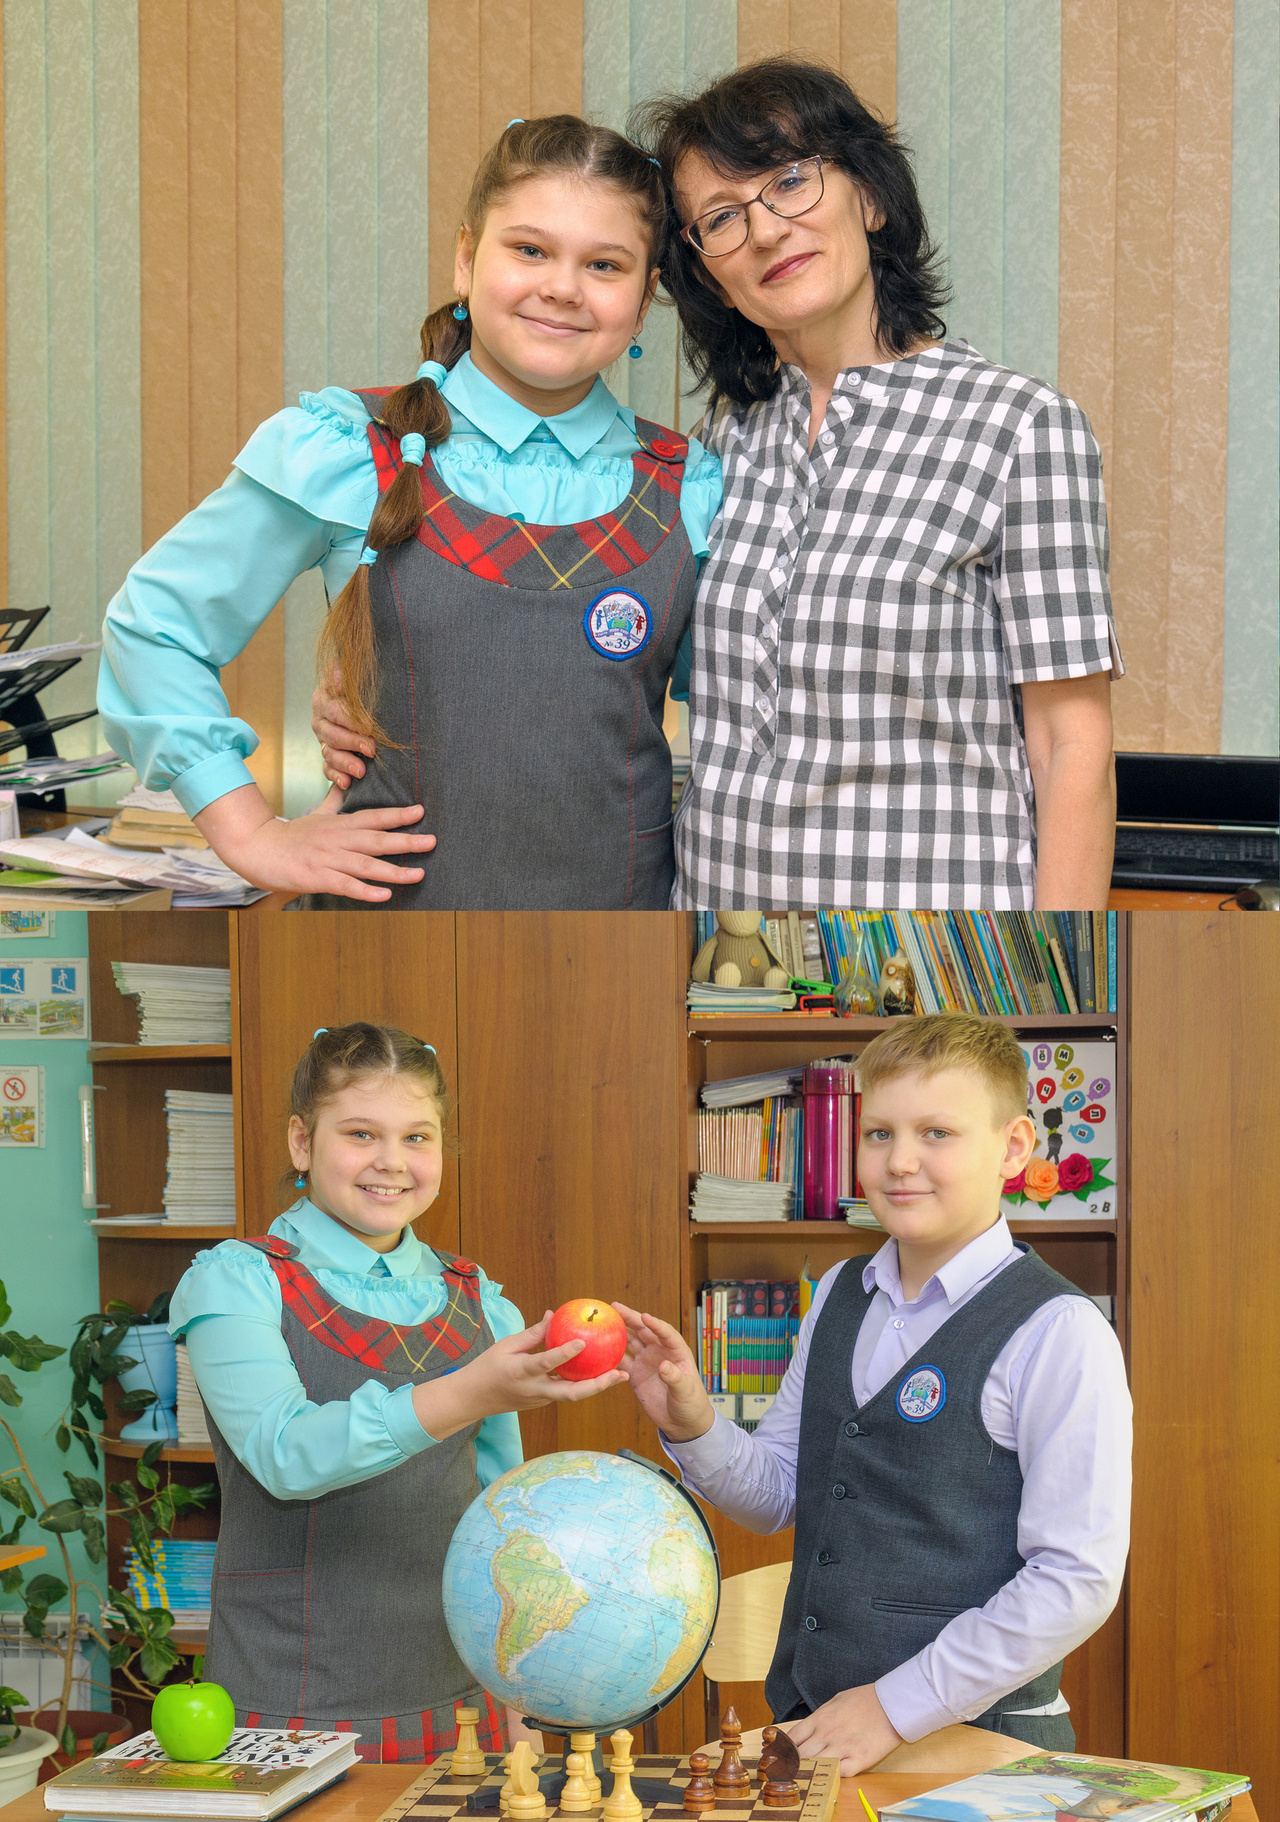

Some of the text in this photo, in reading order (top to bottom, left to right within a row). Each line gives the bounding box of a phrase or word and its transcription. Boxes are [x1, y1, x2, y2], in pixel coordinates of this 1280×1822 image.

[614, 638, 631, 650] 39
[1090, 1204, 1098, 1214] 2
[912, 1404, 926, 1415] 39
